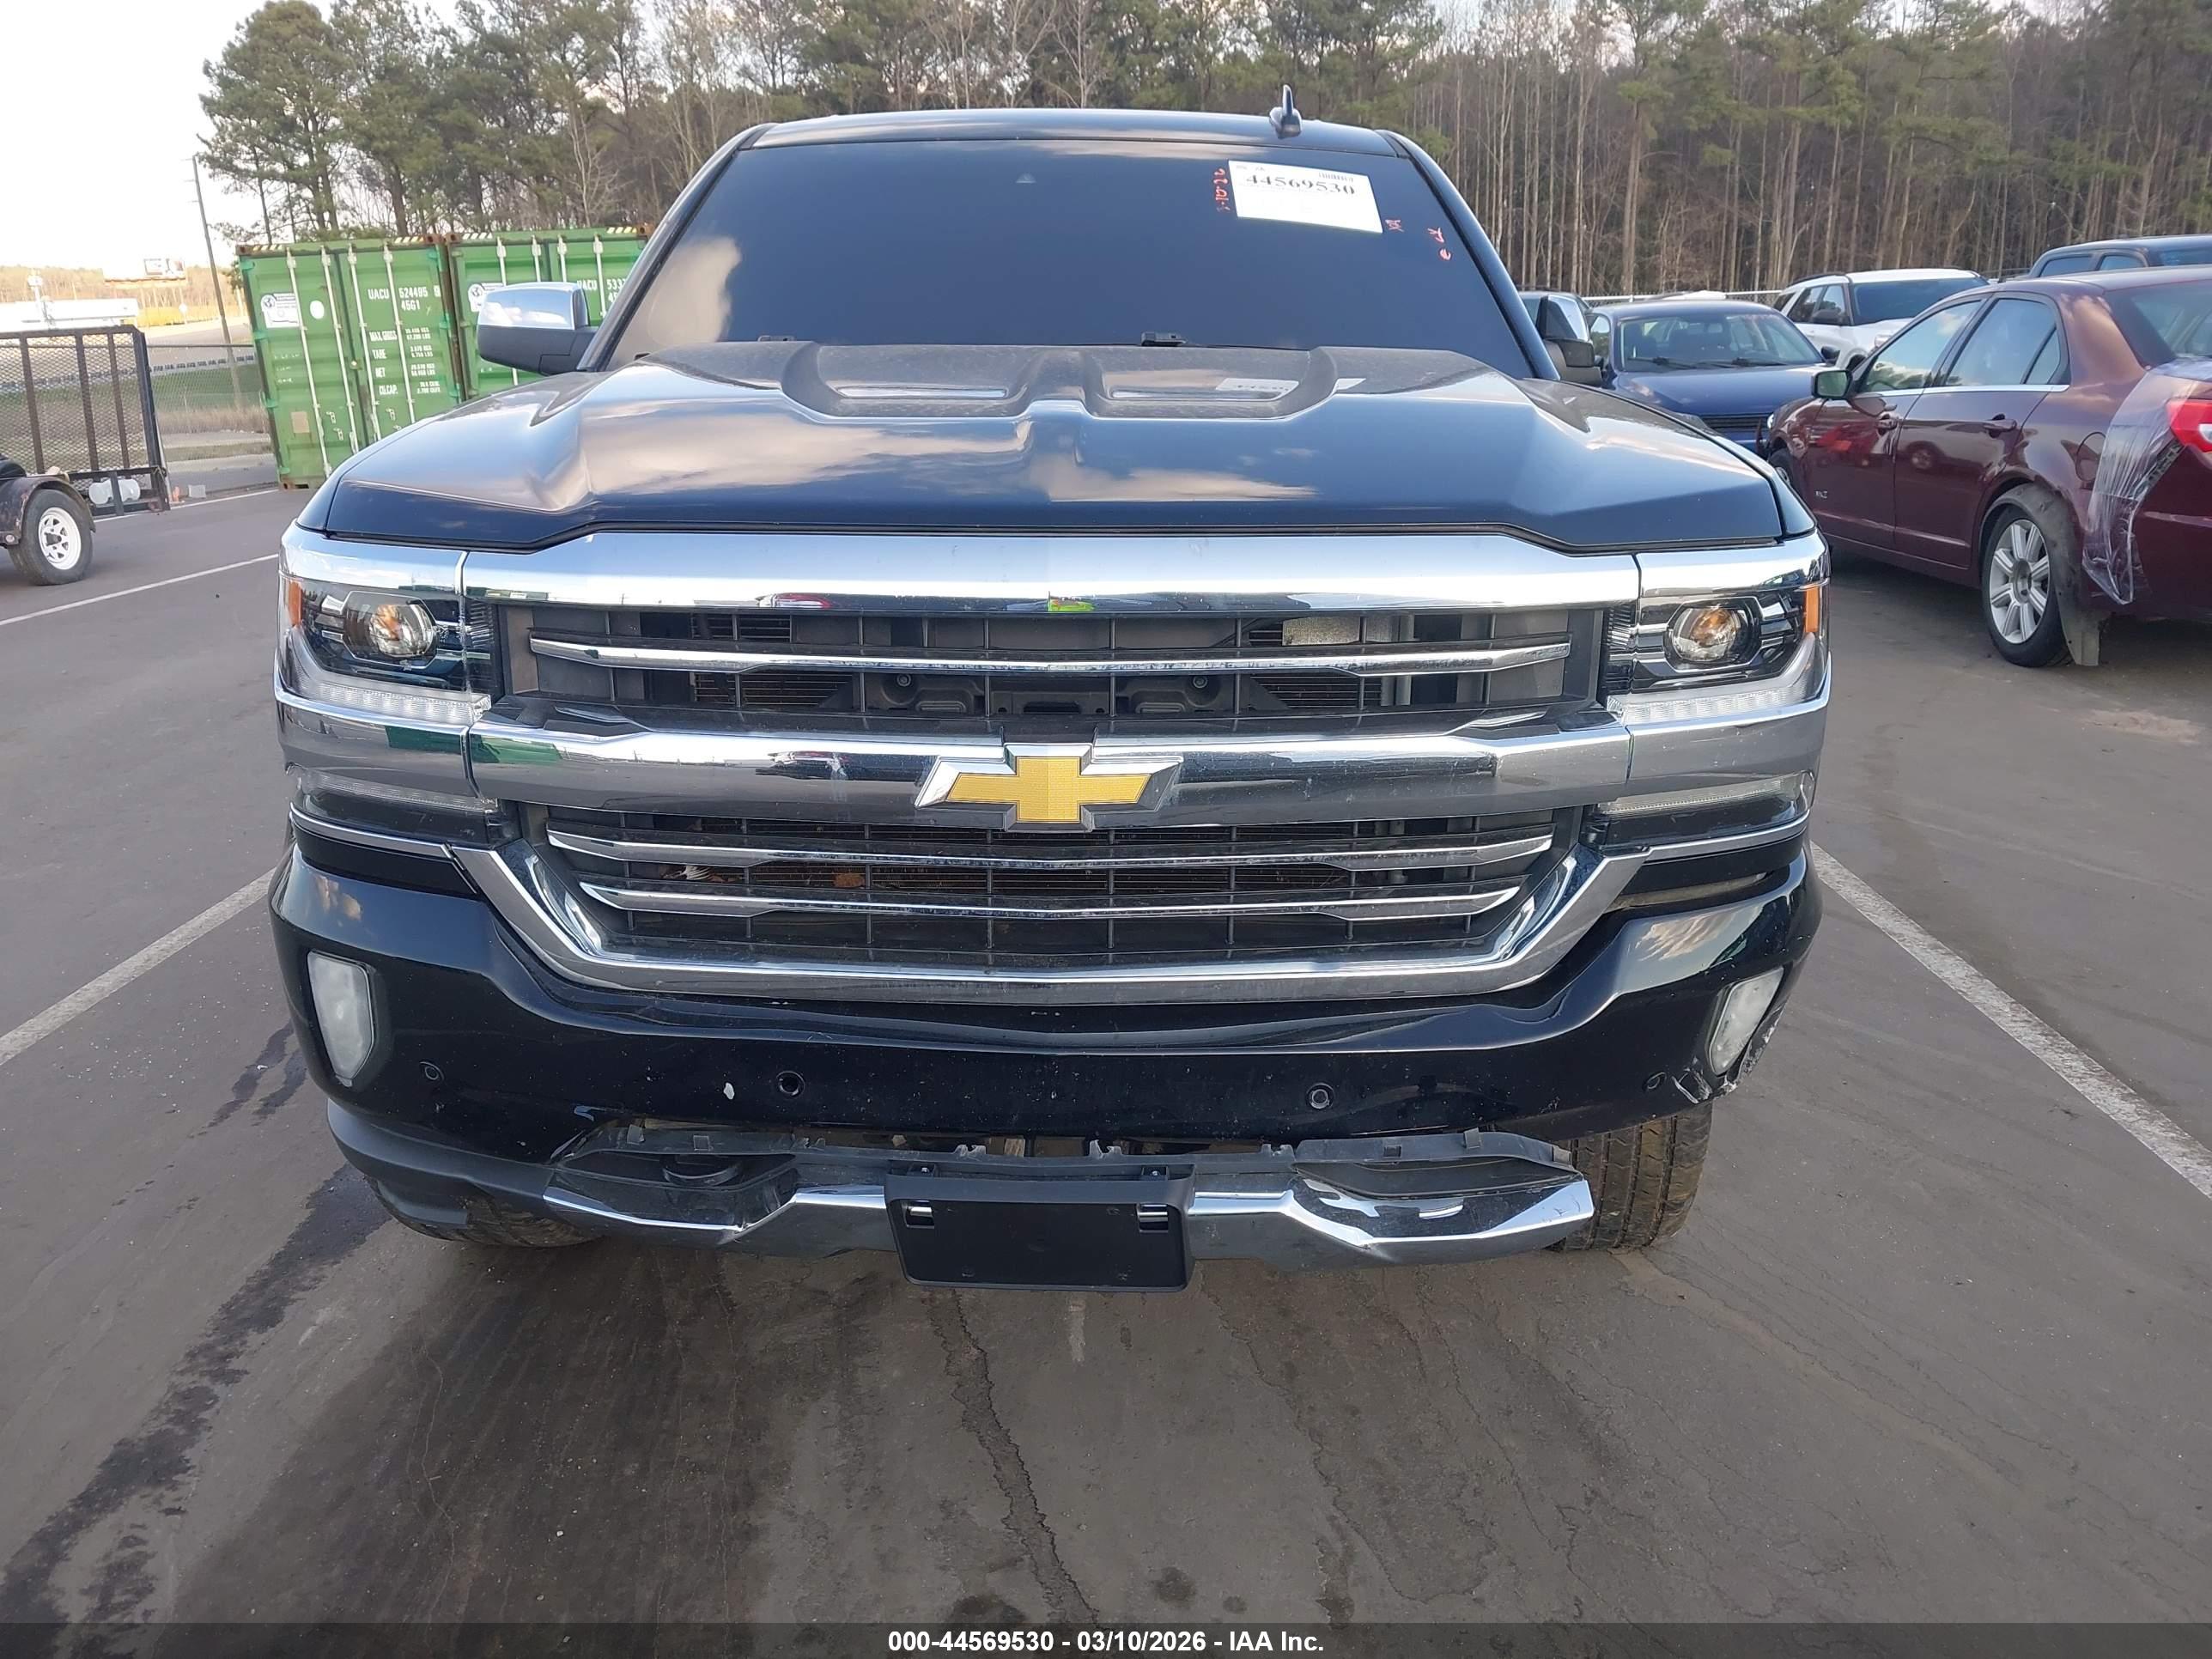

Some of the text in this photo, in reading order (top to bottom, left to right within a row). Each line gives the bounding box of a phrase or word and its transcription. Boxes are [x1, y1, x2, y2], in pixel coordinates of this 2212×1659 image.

[1245, 173, 1356, 196] 44569530
[368, 288, 390, 300] UACU
[398, 286, 428, 298] 524495
[401, 299, 421, 312] 45G1
[372, 349, 387, 360] TARE
